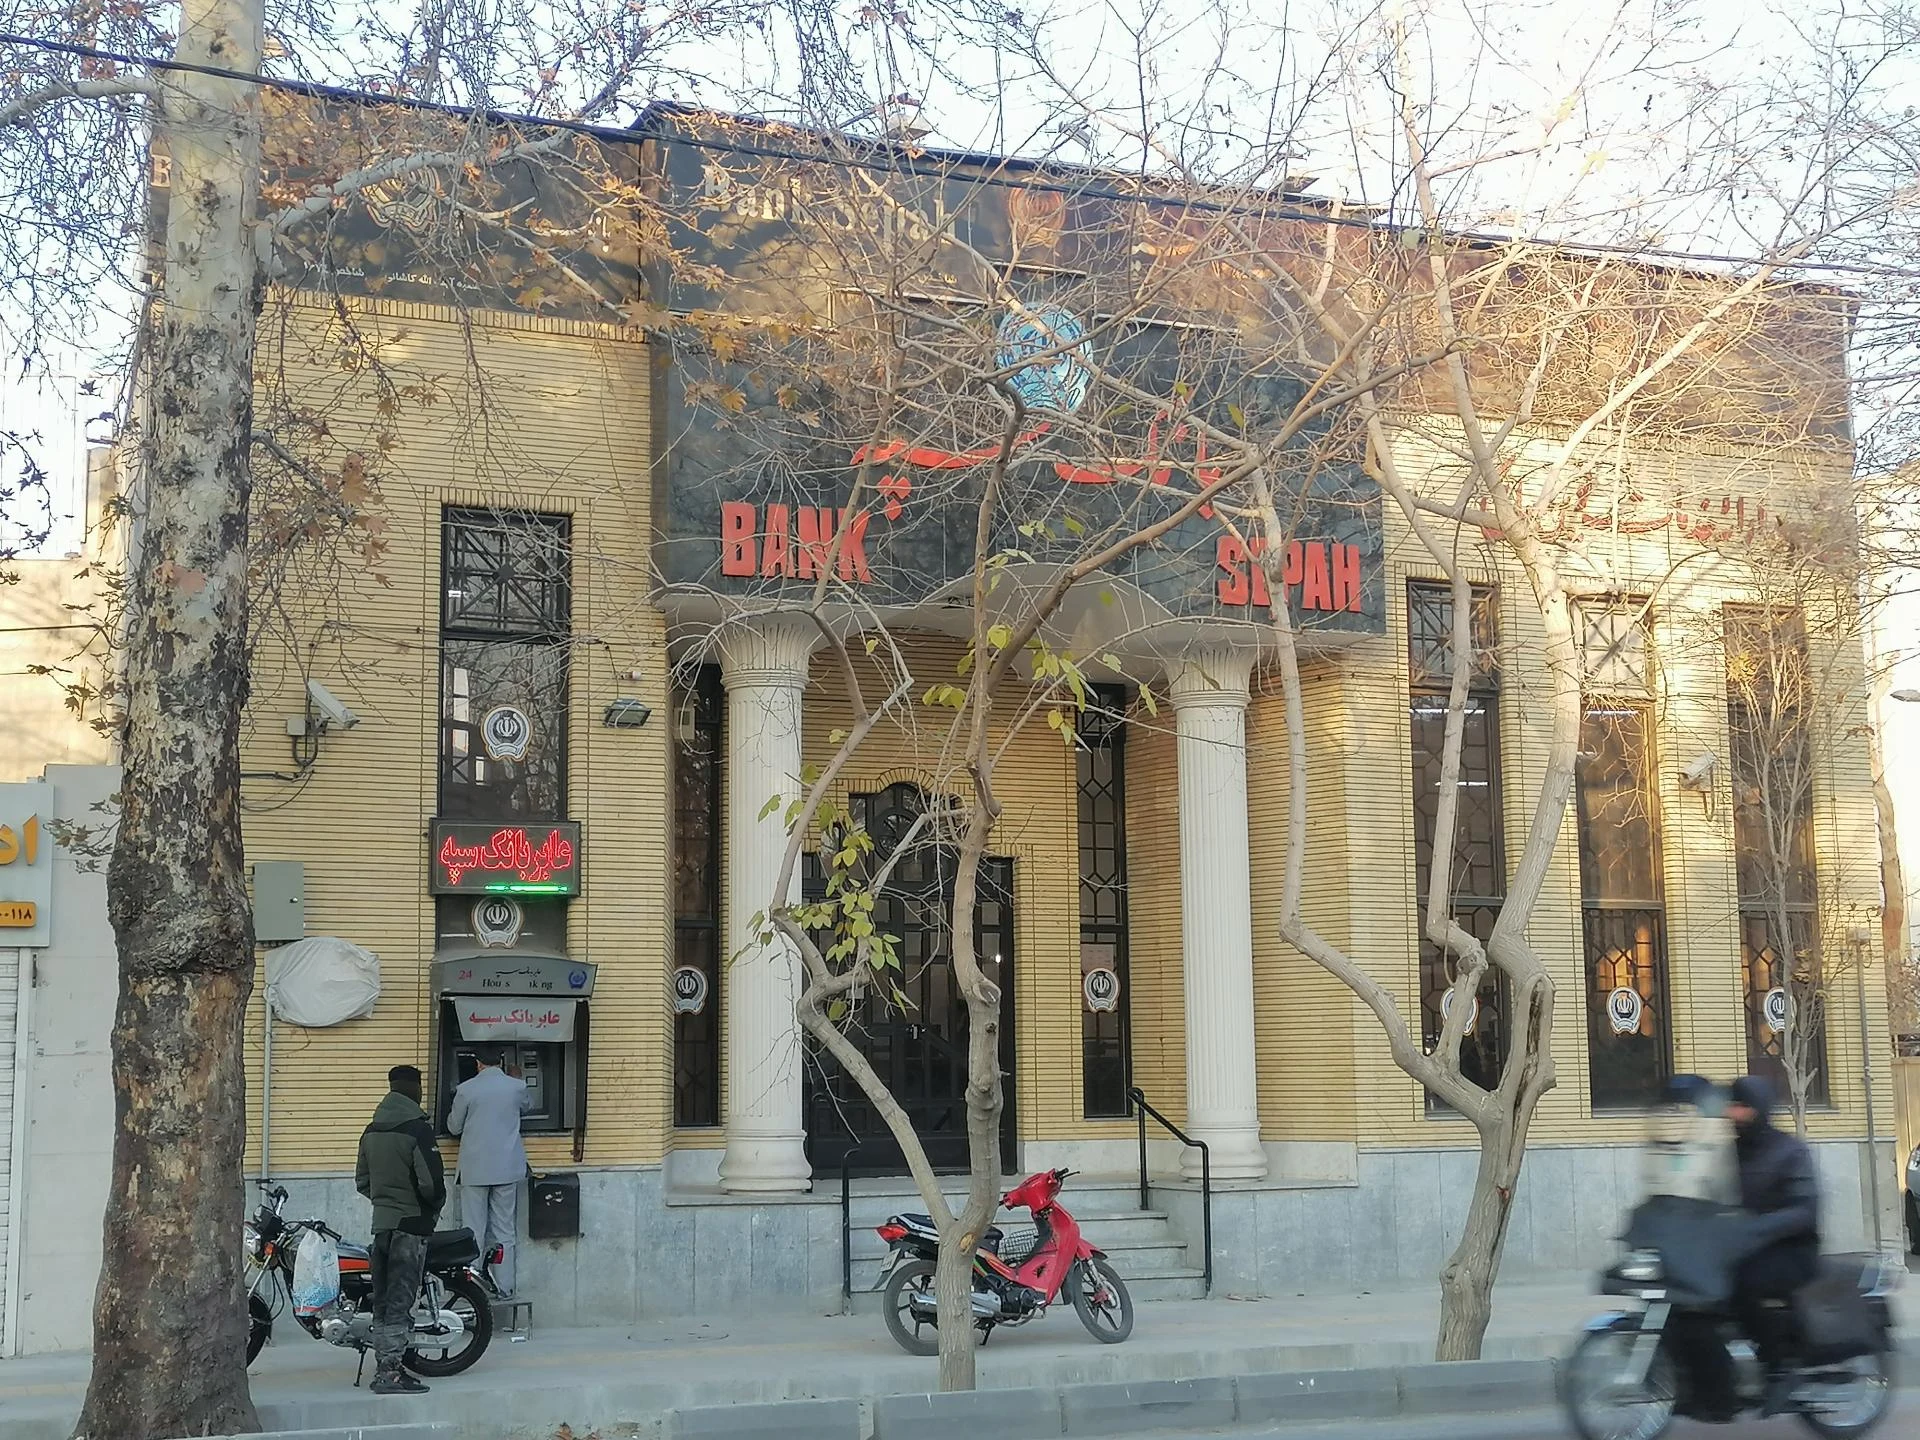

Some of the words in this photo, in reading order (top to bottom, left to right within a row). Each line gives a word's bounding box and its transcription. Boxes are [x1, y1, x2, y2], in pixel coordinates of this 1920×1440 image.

[722, 501, 873, 582] BANK
[440, 836, 479, 885] سپه
[480, 829, 531, 880] بانک
[529, 829, 572, 882] عابر
[458, 969, 473, 980] 24
[469, 1011, 502, 1029] سپه
[504, 1009, 534, 1028] بانک
[536, 1010, 560, 1028] عابر
